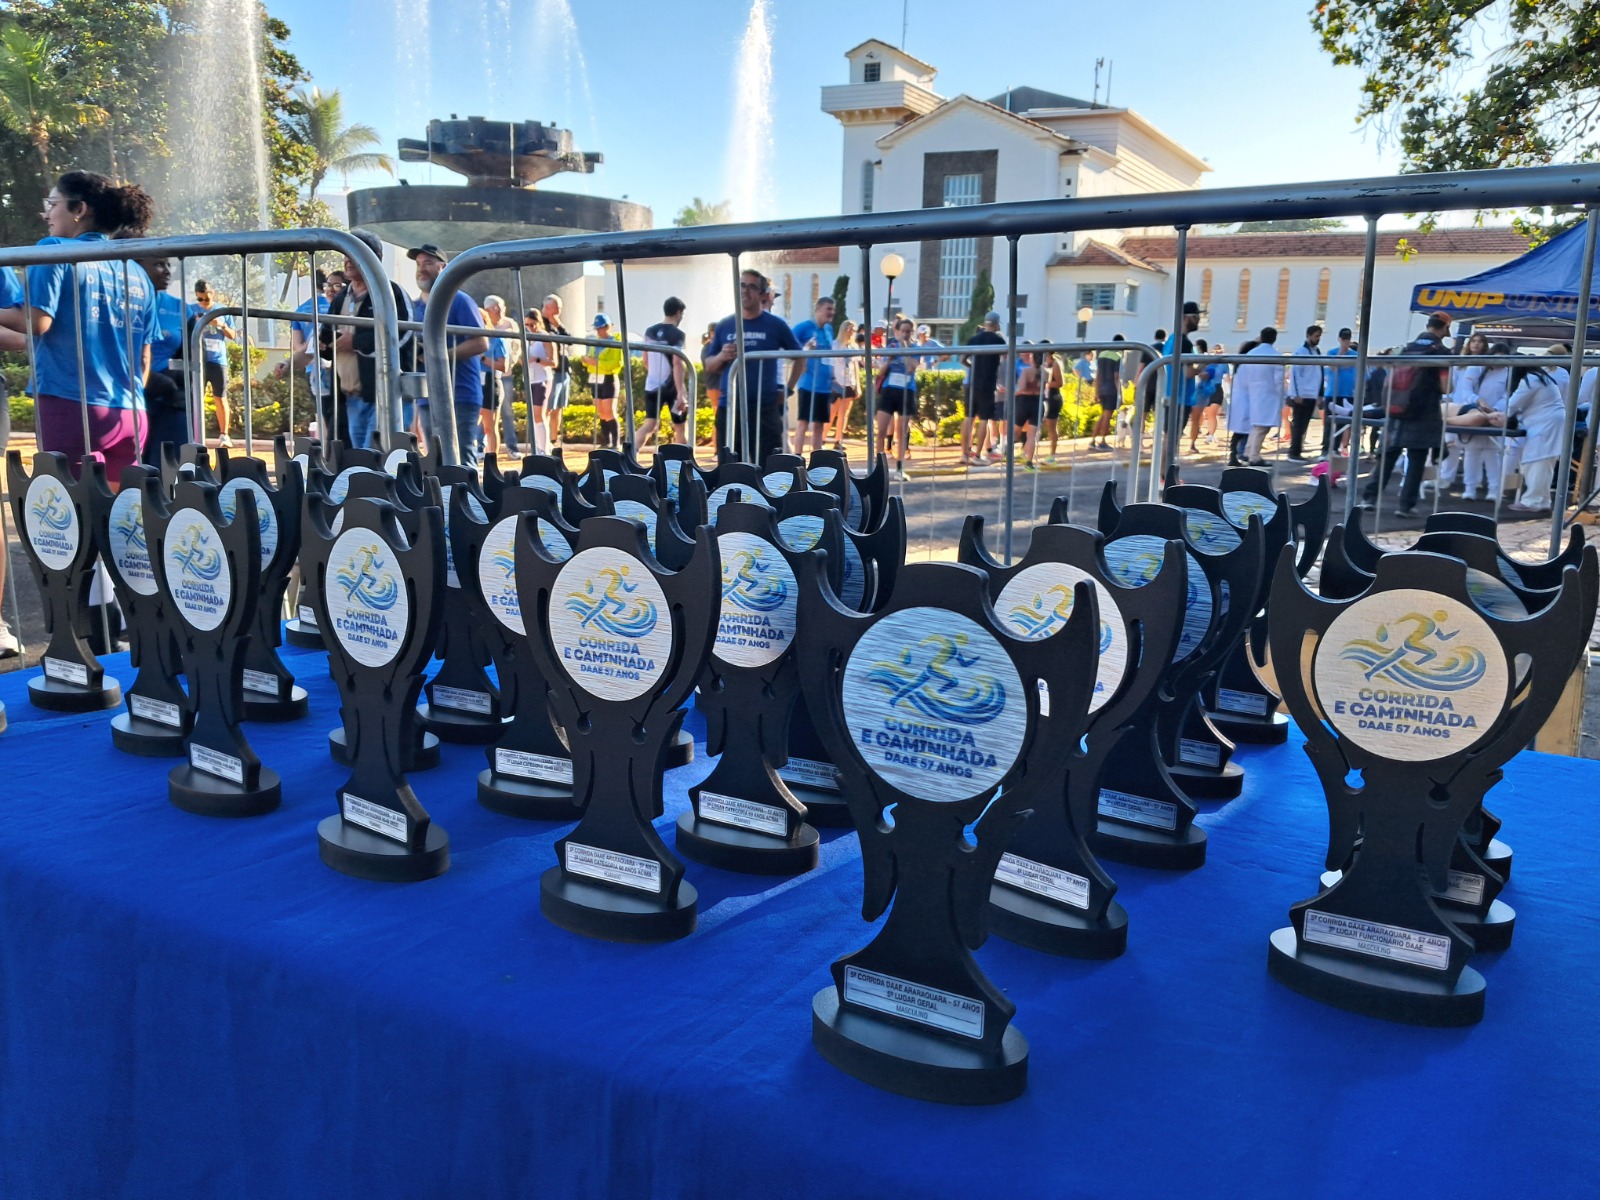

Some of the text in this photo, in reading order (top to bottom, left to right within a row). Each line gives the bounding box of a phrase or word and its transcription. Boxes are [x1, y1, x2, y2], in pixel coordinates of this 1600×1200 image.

[1417, 288, 1505, 309] UNIP
[175, 589, 224, 606] E CAMINHADA
[492, 595, 498, 604] E
[346, 610, 387, 626] CORRIDA
[720, 612, 770, 626] ORRIDA
[337, 618, 398, 640] E CAMINHADA
[719, 623, 784, 640] AMINHADA
[348, 633, 363, 643] DAAE
[372, 639, 388, 648] ANOS
[579, 635, 640, 655] CORRIDA
[716, 636, 736, 644] DAAE
[748, 640, 770, 648] ANOS
[564, 647, 655, 671] E CAMINHADA
[581, 664, 640, 680] DAAE 57 ANOS
[1358, 688, 1454, 711] CORRIDA
[1334, 700, 1478, 728] E CAMINHADA
[884, 716, 976, 747] CORRIDA
[1358, 720, 1450, 738] DAAE 57 ANOS
[862, 728, 998, 767] E CAMINHADA
[884, 752, 973, 778] DAAE 57 ANOS
[1318, 916, 1346, 927] CORRIDA
[1348, 922, 1366, 931] DAAE
[1367, 926, 1412, 940] ARARAQUARA
[1427, 938, 1446, 948] ANOS
[1336, 928, 1358, 937] LUGAR
[1406, 942, 1424, 951] DAAE
[1358, 942, 1390, 954] MASCULINO
[858, 973, 885, 987] CORRIDA
[886, 981, 902, 992] DAAE
[904, 986, 946, 1004] ARARAQUARA
[962, 1002, 980, 1014] ANOS
[895, 993, 916, 1004] LUGAR
[917, 999, 938, 1010] GERAL
[896, 1004, 928, 1019] MASCULINO
